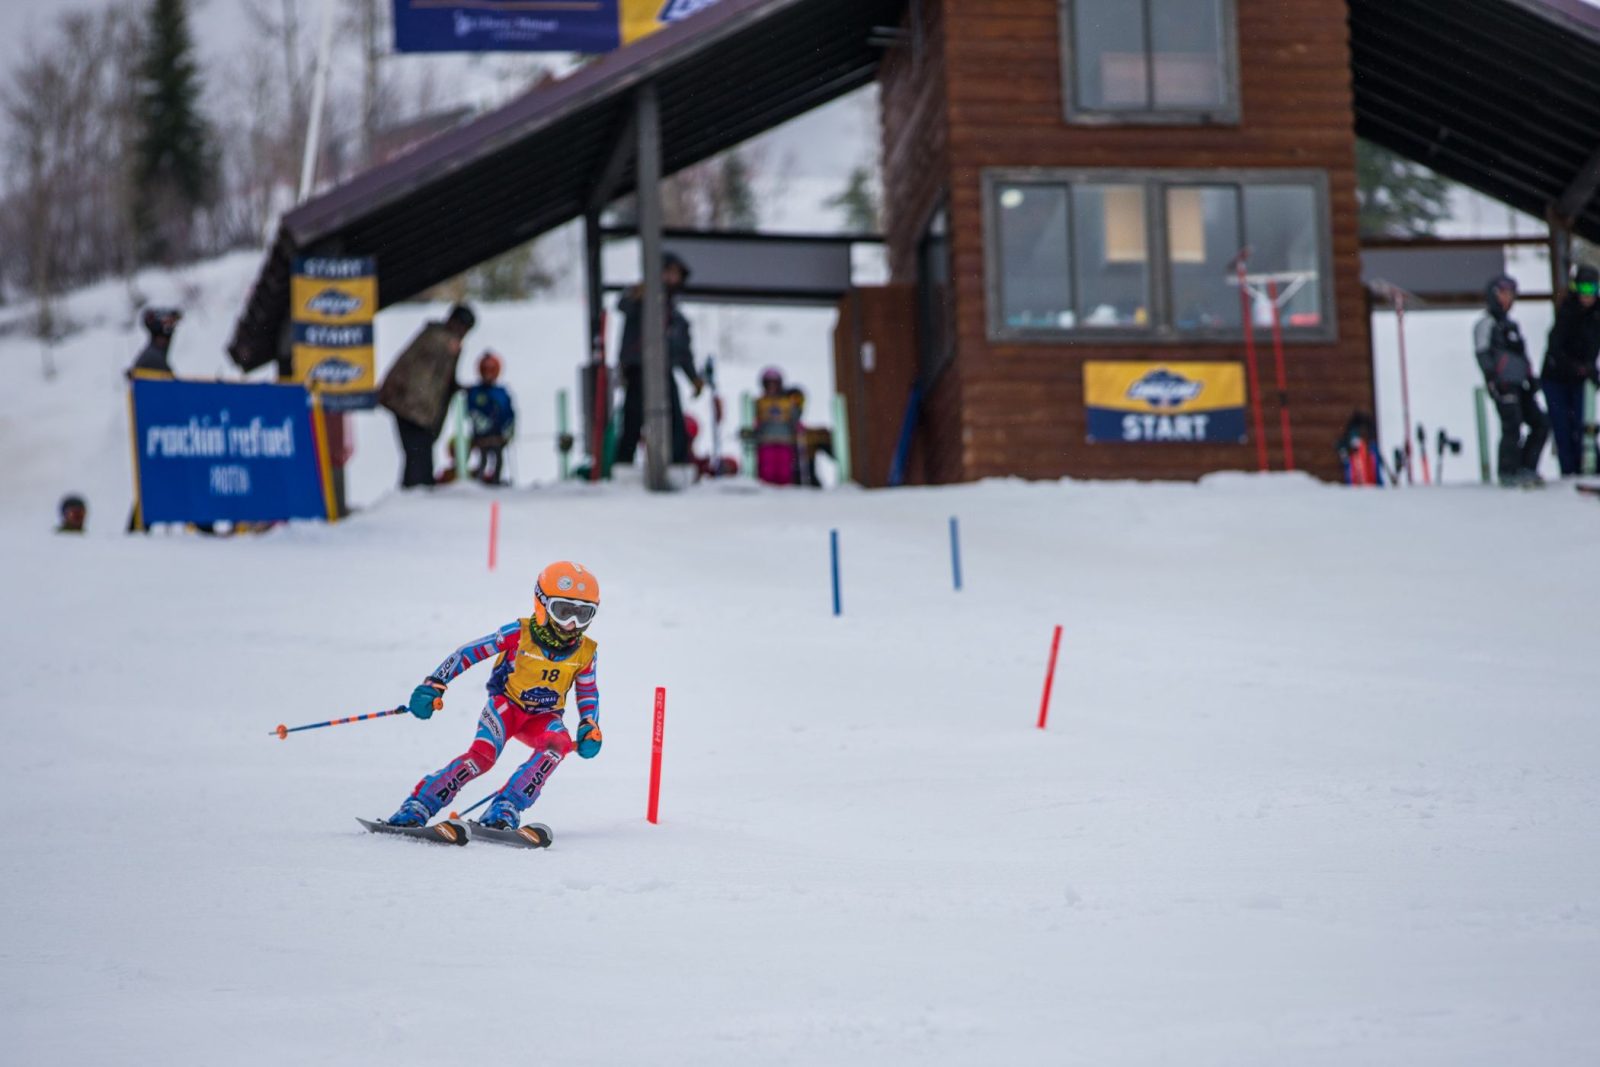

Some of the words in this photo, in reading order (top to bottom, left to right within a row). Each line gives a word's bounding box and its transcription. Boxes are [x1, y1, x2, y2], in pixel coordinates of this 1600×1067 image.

[304, 258, 362, 277] START
[305, 326, 364, 345] START
[1122, 414, 1210, 441] START
[541, 669, 560, 682] 18
[523, 693, 557, 703] NATIONAL
[436, 768, 470, 802] USA
[522, 759, 553, 798] USA
